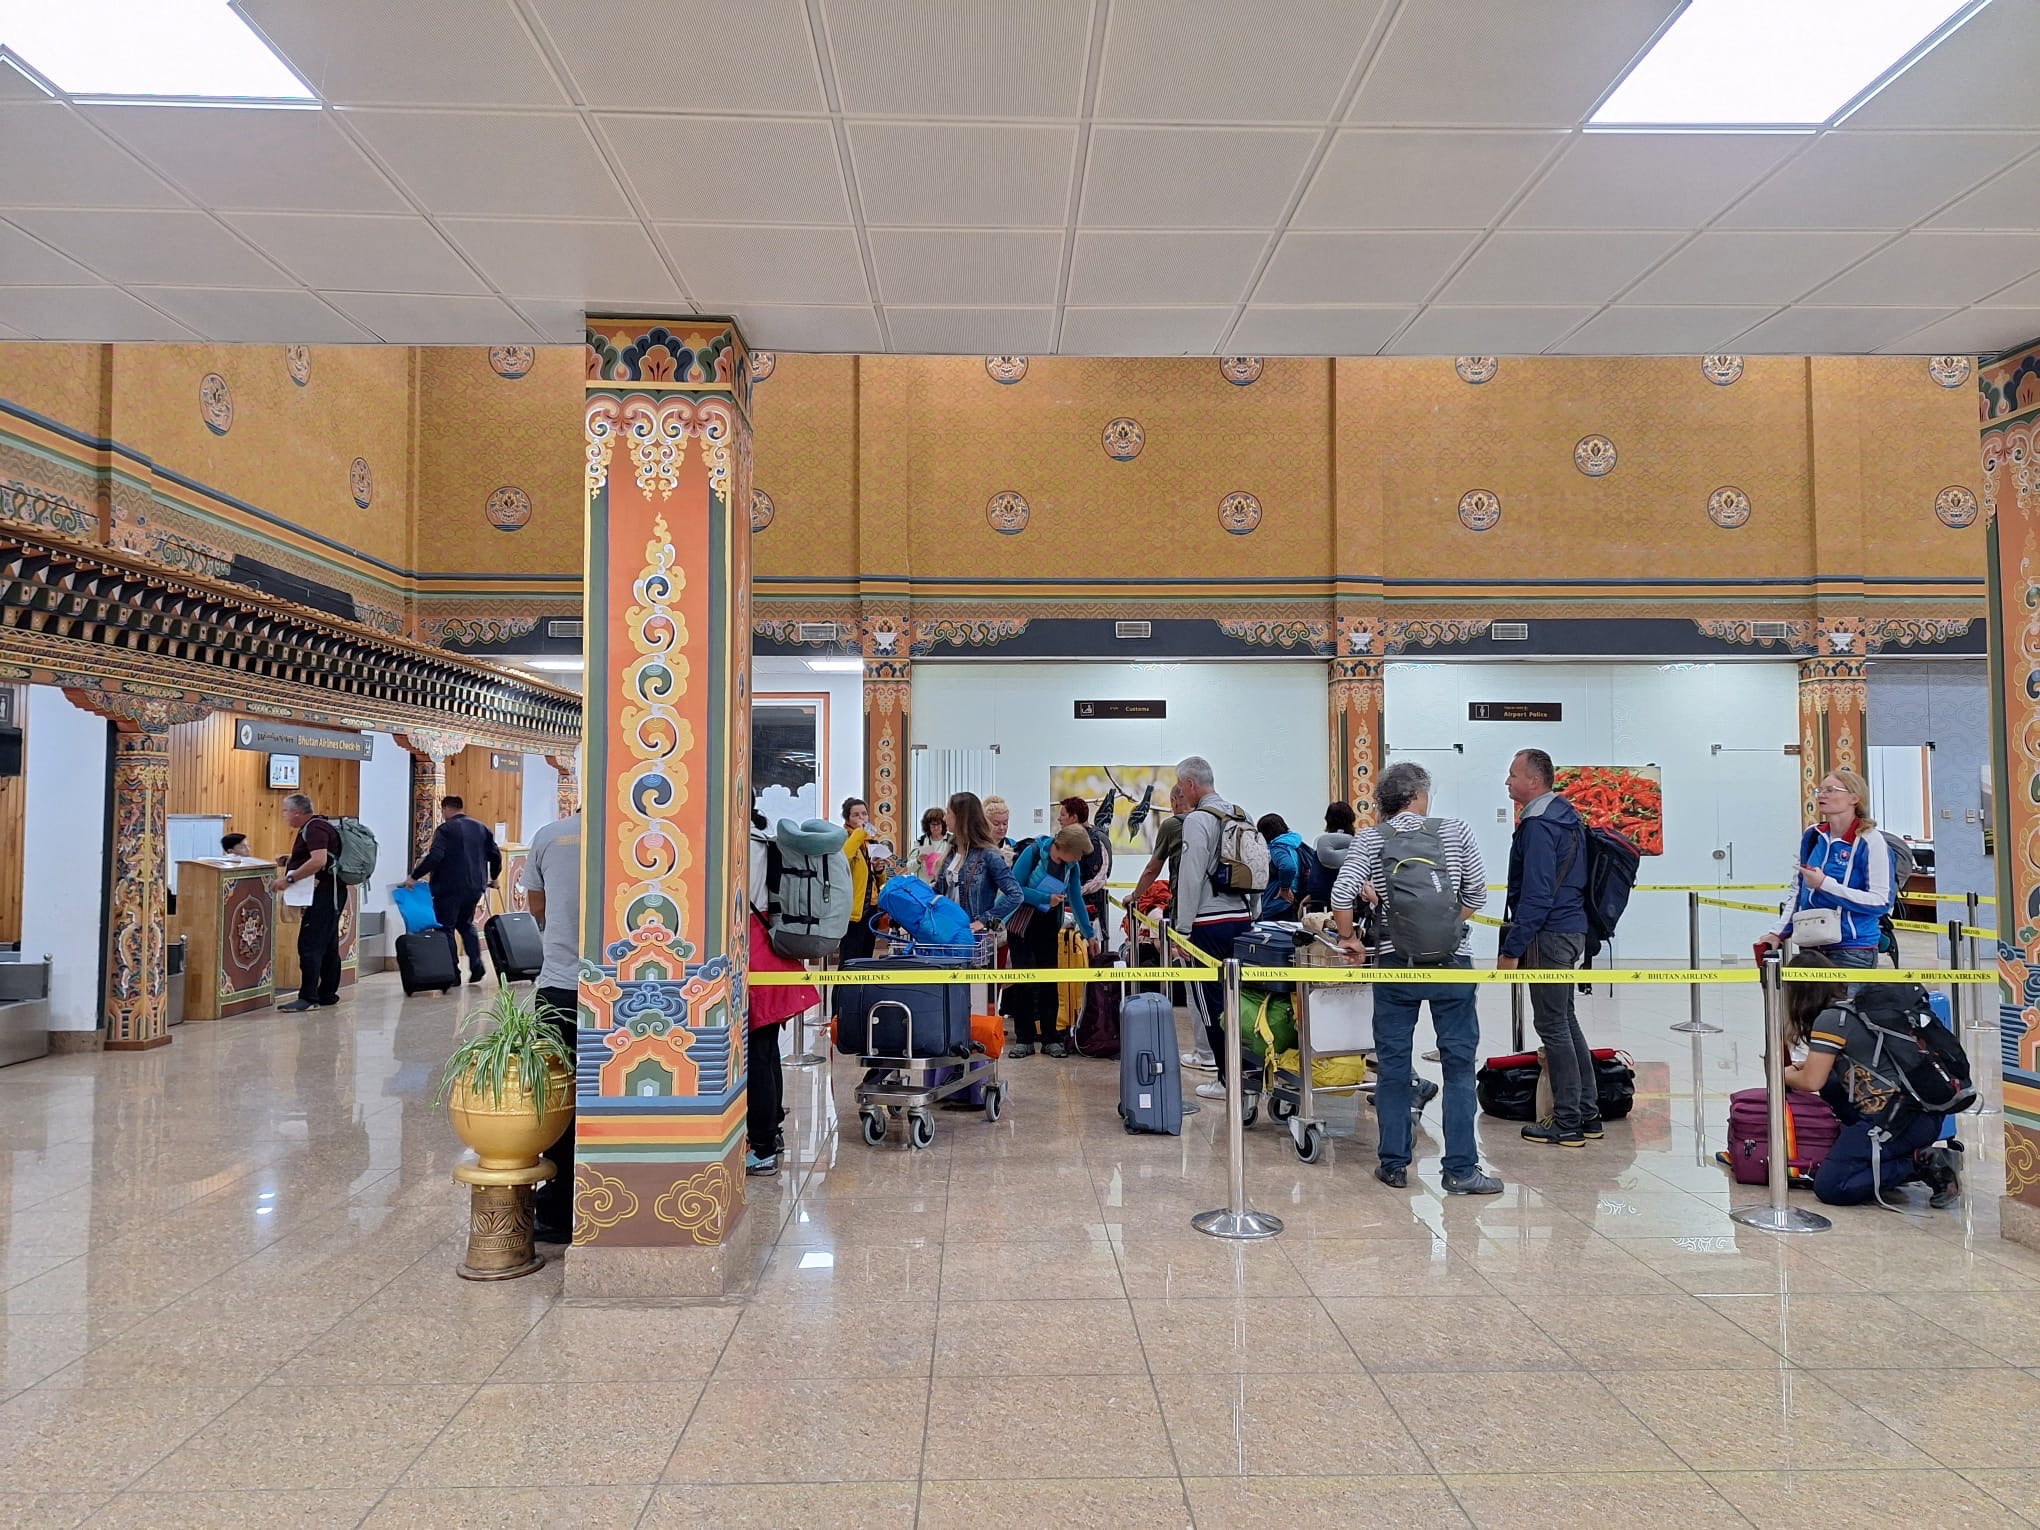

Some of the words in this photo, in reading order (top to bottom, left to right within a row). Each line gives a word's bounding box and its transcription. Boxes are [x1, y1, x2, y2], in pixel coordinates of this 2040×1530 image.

[1503, 711, 1527, 719] Airport
[297, 735, 319, 747] Bhutan
[319, 738, 339, 750] Airlines
[819, 974, 853, 982] BHUTAN
[998, 972, 1036, 980] AIRLINES
[1109, 971, 1142, 979] BHUTAN
